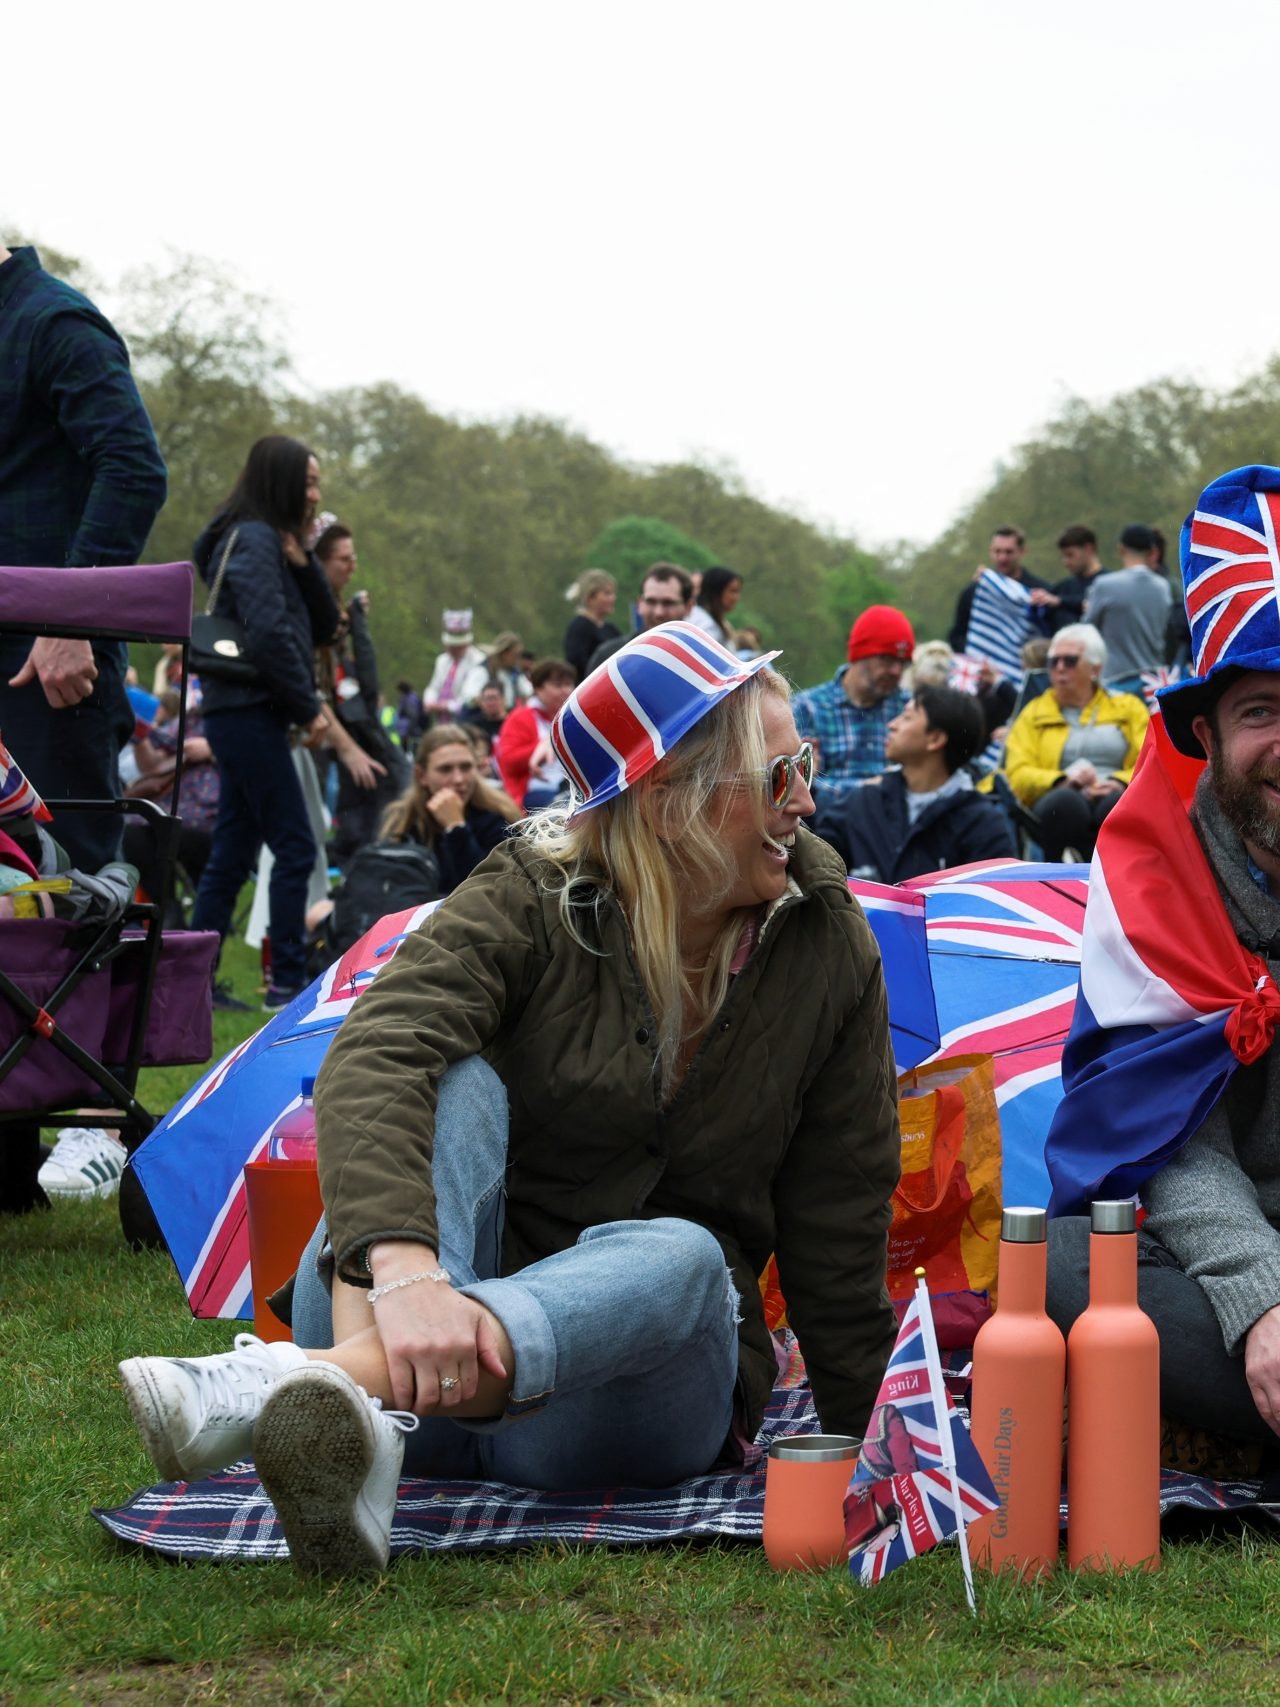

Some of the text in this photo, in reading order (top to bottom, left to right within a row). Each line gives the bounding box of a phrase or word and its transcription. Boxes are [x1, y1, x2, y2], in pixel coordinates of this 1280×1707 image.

[993, 1407, 1017, 1450] Days
[992, 1451, 1011, 1487] Pair
[898, 1474, 927, 1536] harles III
